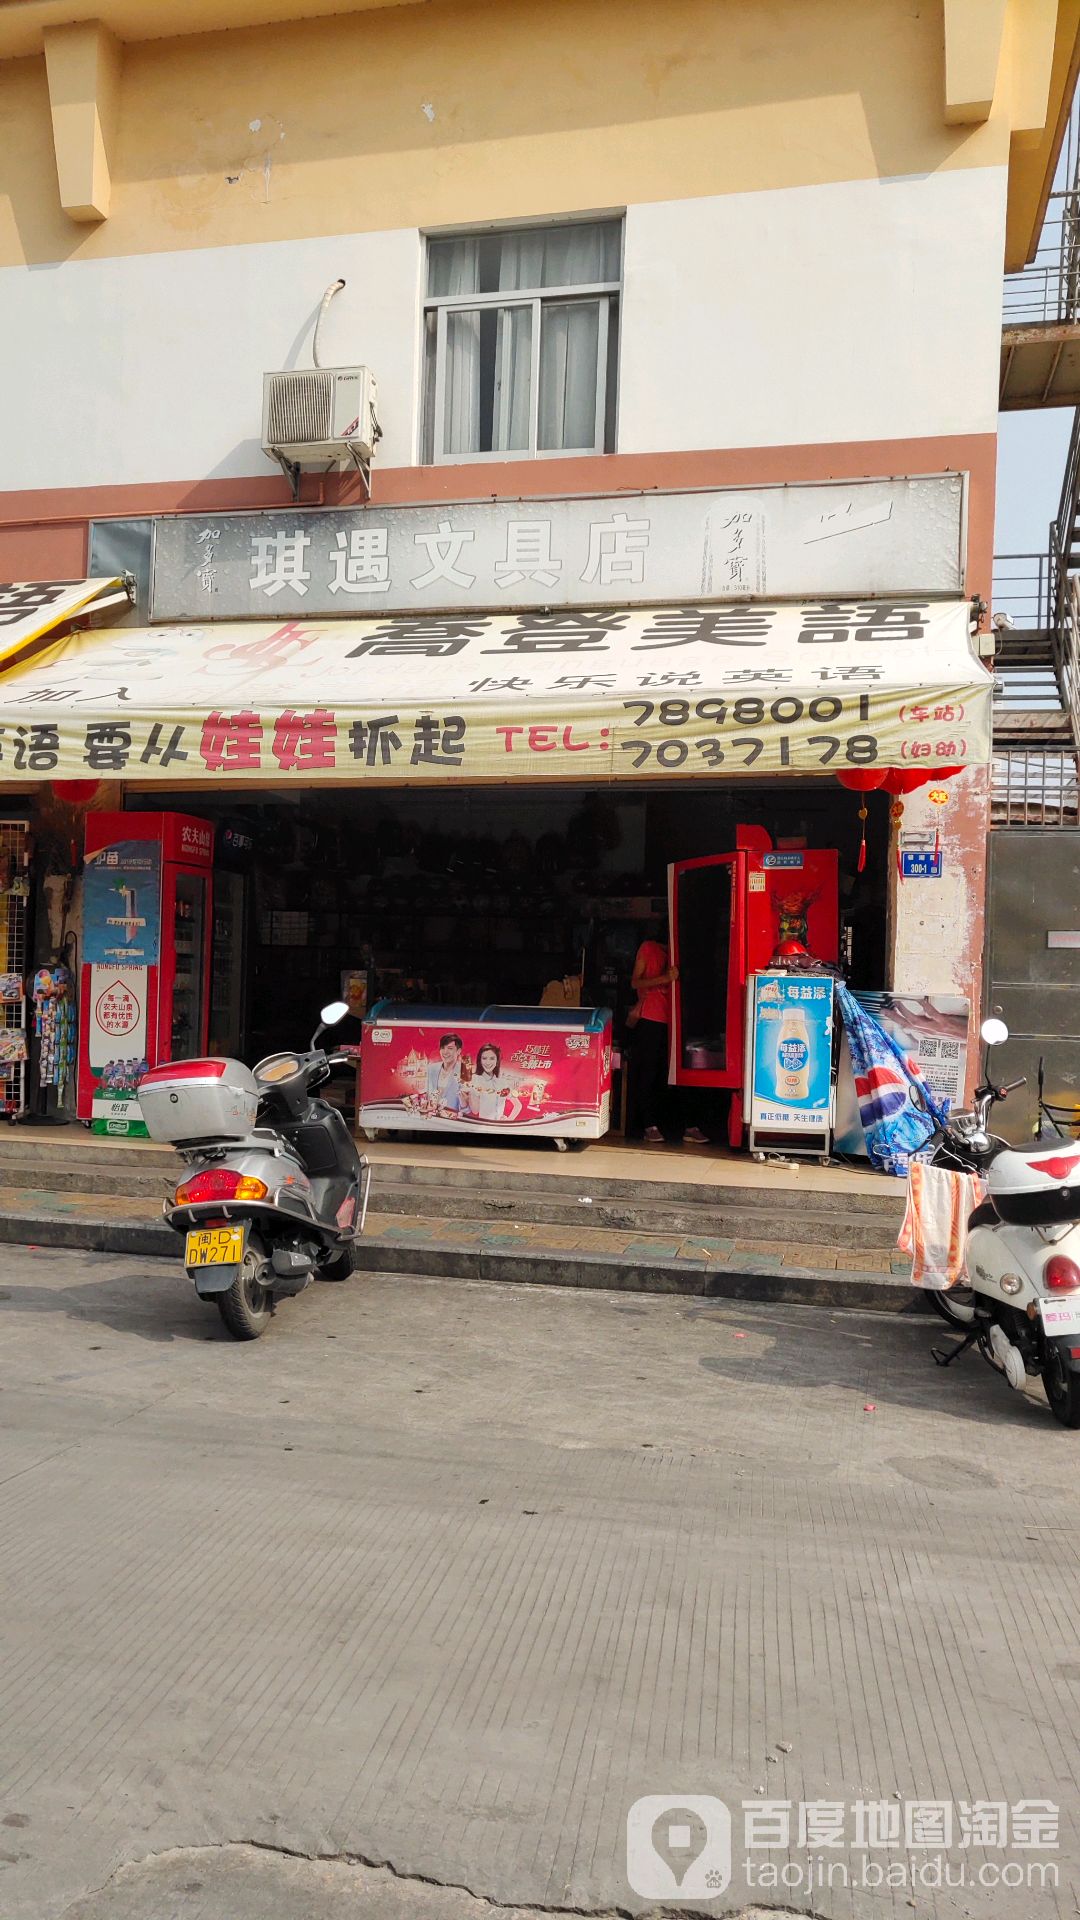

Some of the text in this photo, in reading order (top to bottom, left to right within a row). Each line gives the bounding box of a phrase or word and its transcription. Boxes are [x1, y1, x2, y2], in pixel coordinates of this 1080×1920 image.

[249, 512, 651, 597] 琪遇文具店
[467, 665, 885, 693] 快乐说英语
[623, 694, 870, 727] 7898001
[0, 708, 466, 771] 语要从娃娃抓起
[621, 735, 879, 769] 7037178
[910, 863, 927, 874] 300-1
[103, 1003, 133, 1012] 农夫山泉
[188, 1245, 237, 1265] DW271
